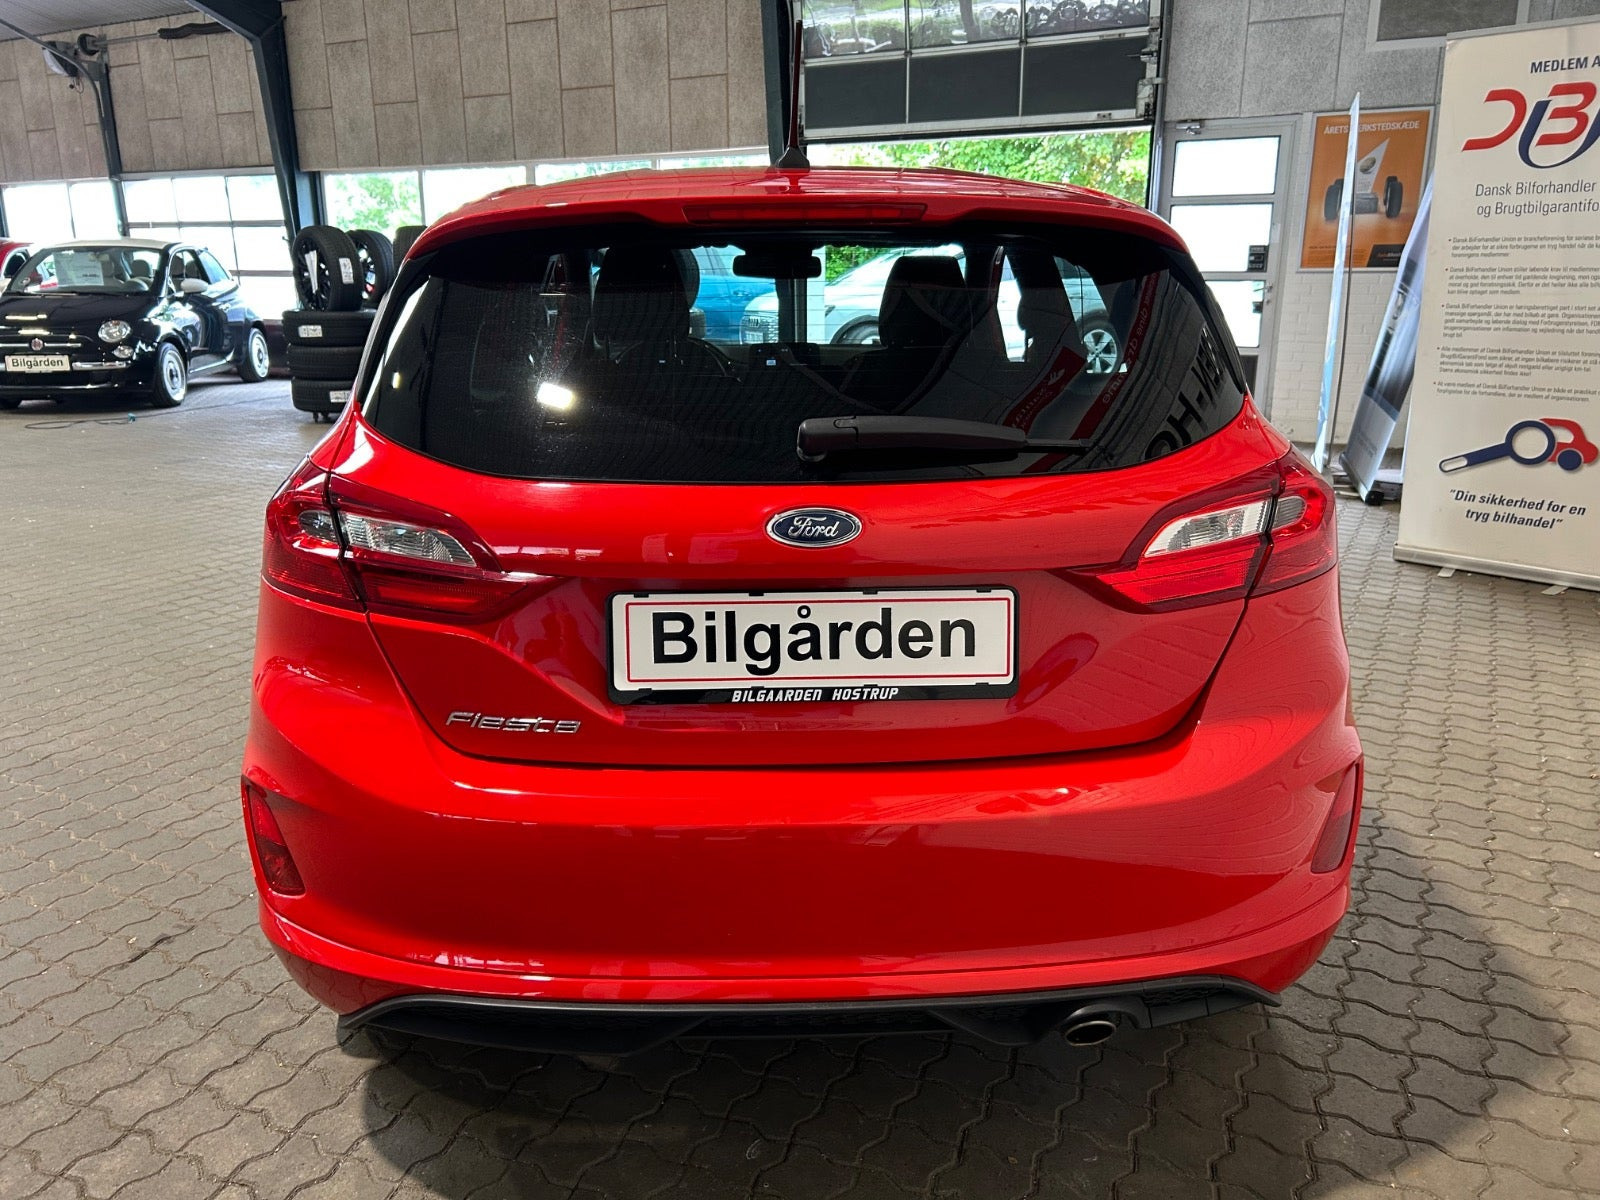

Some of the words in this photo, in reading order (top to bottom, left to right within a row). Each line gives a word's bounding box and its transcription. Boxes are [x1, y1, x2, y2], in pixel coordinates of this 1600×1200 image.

[1530, 57, 1588, 73] MEDLEM
[1324, 125, 1349, 135] ÅRETS
[1356, 120, 1420, 132] ERKSTEDSKÆDE
[1475, 184, 1512, 197] Dansk
[1515, 179, 1596, 195] Bilforhandler
[1477, 205, 1491, 218] og
[11, 357, 64, 369] Bilgården
[1478, 493, 1545, 511] sikkerhed
[1546, 500, 1566, 513] for
[1569, 505, 1587, 516] en
[1465, 509, 1490, 523] tryg
[788, 514, 839, 539] Ford
[652, 605, 976, 676] Bilgården
[731, 689, 823, 703] BILGAARDEN
[831, 687, 899, 702] HOSTRUP
[445, 710, 582, 735] Fiesta
